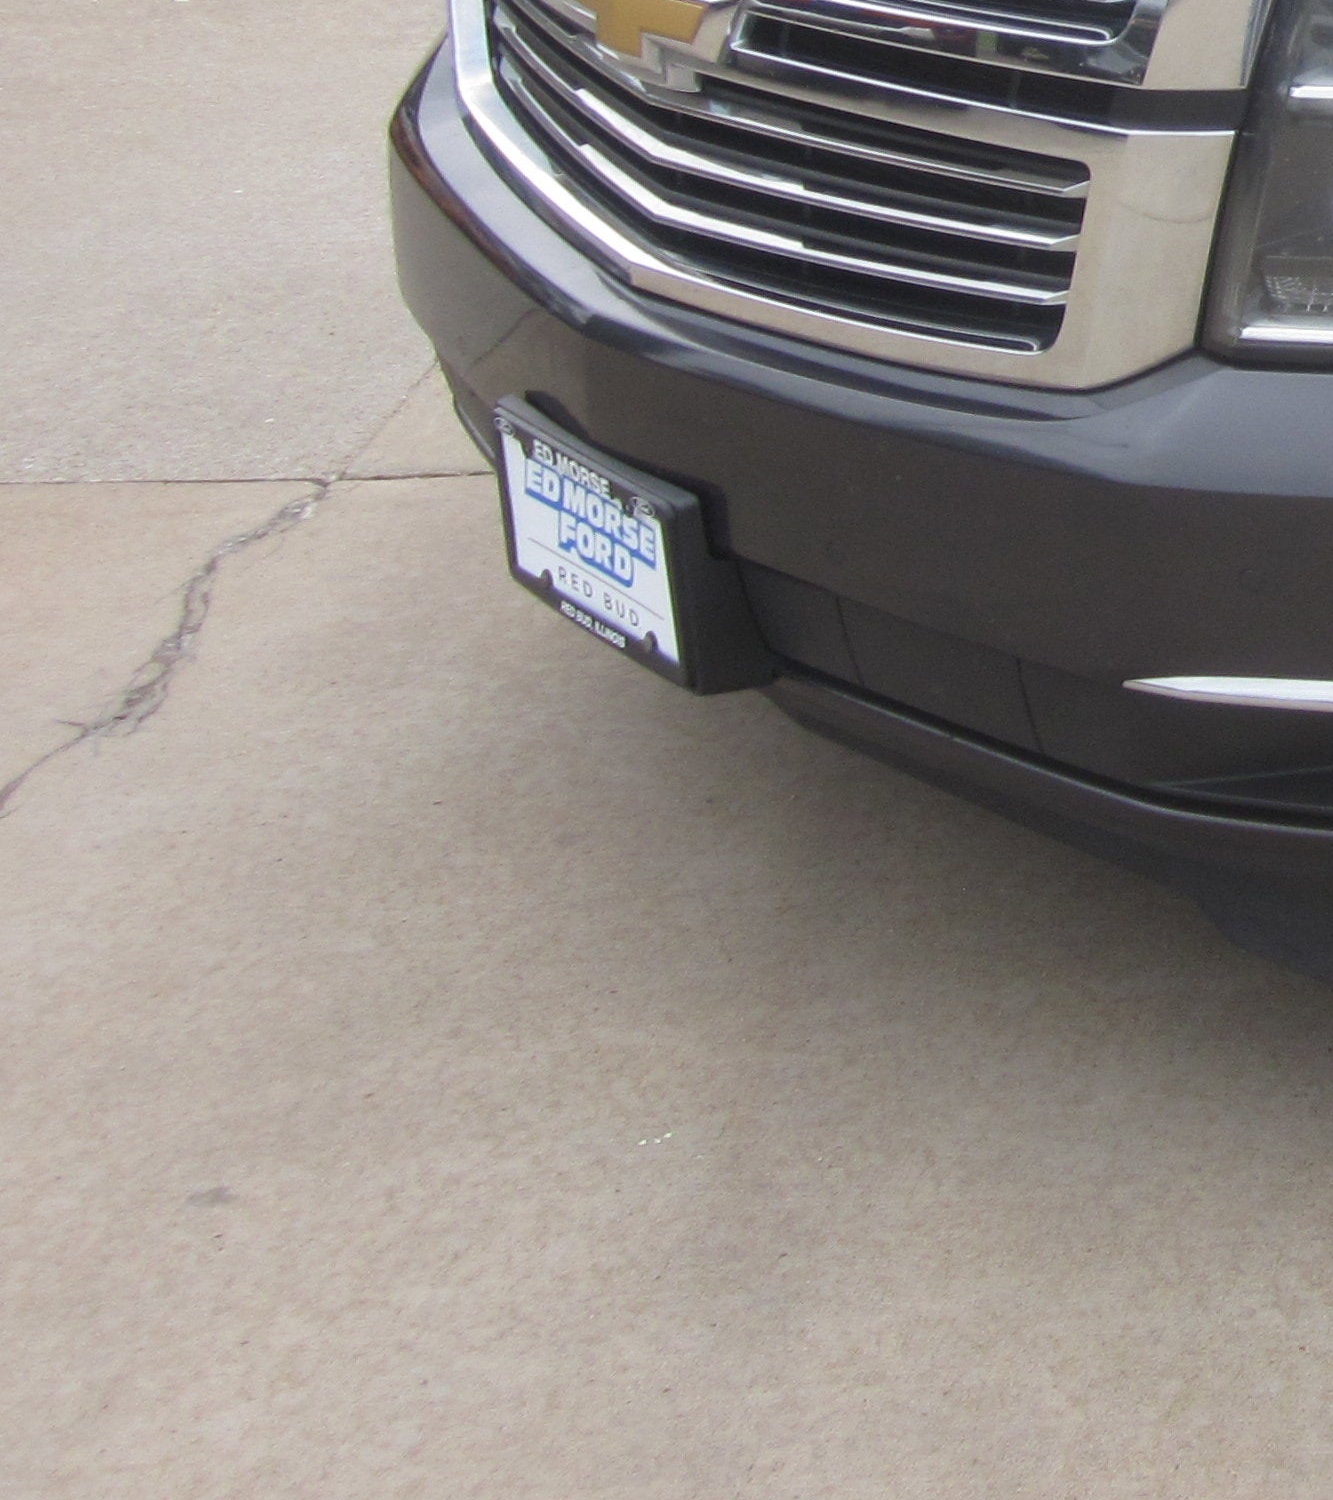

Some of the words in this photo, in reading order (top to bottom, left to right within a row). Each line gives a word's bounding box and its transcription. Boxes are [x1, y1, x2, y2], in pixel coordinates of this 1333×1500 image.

[532, 438, 555, 467] ED
[525, 458, 562, 512] ED
[560, 473, 657, 570] MORSE
[558, 510, 634, 588] FORD
[558, 565, 593, 598] RED
[603, 591, 640, 627] BUD
